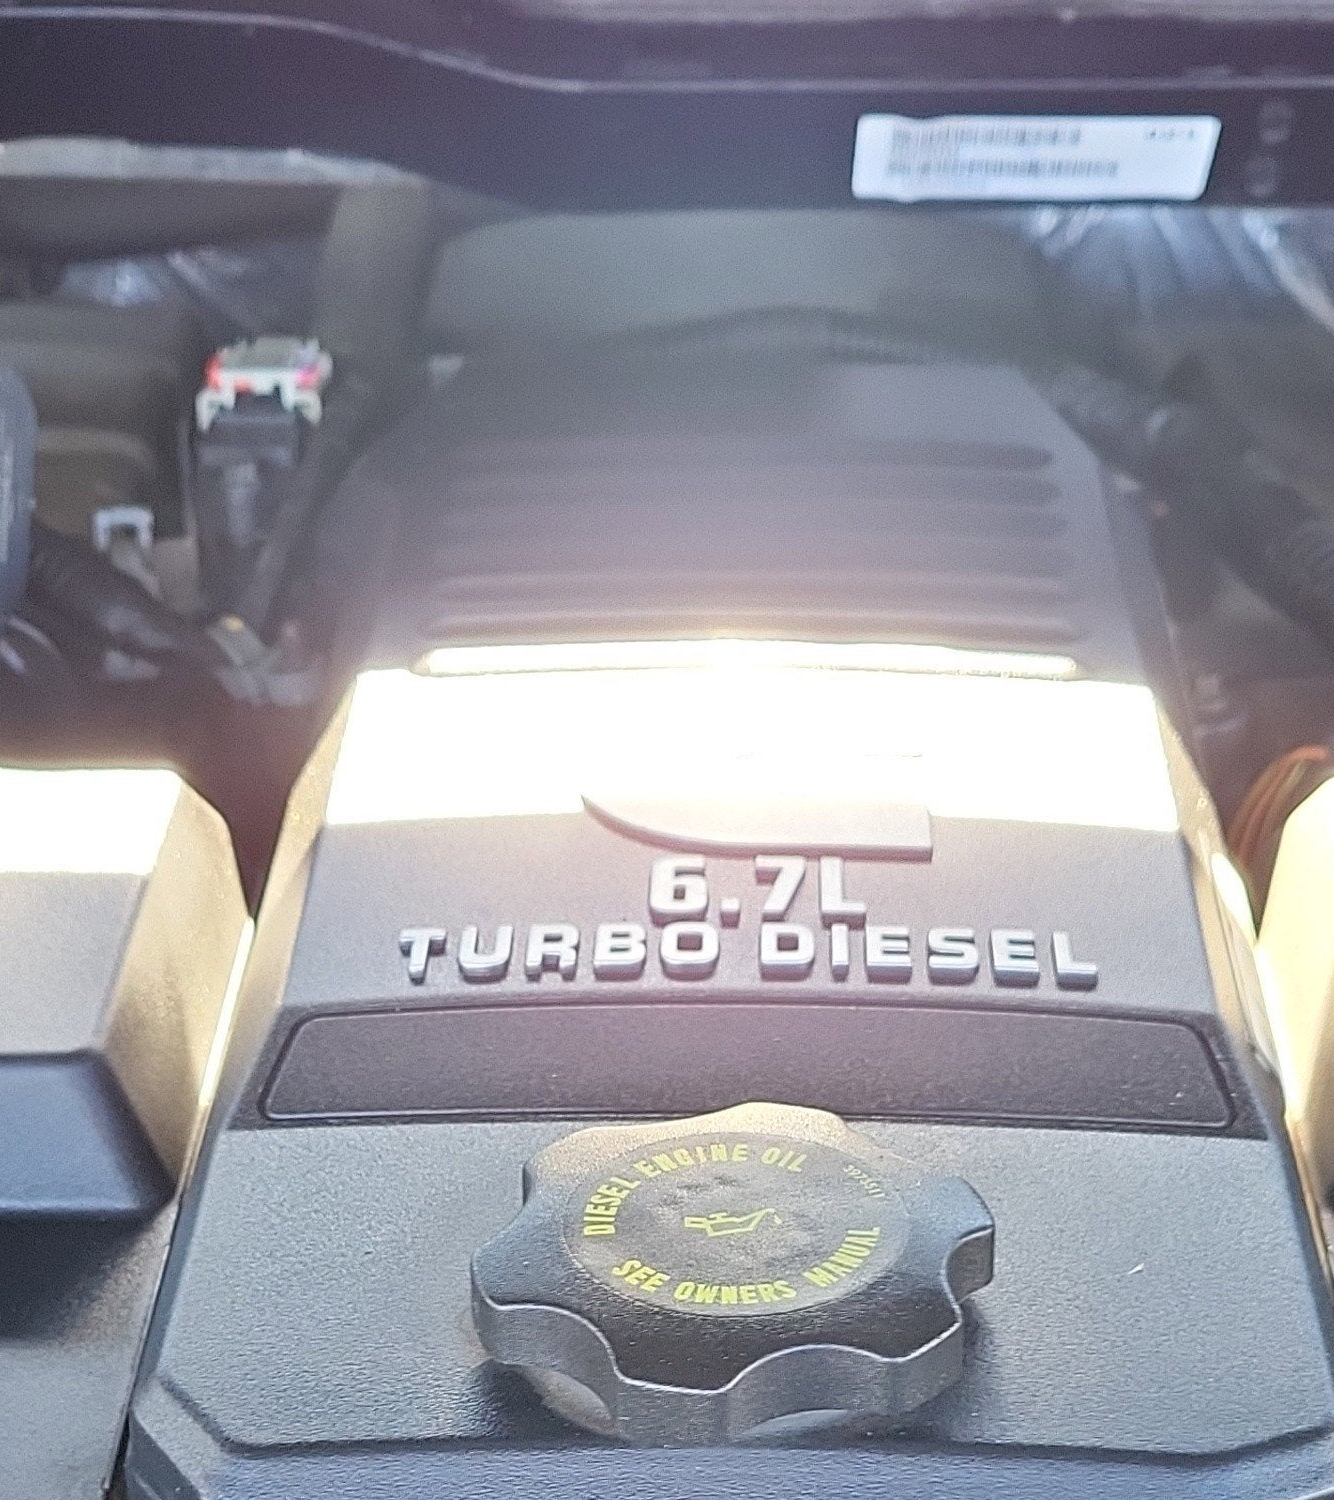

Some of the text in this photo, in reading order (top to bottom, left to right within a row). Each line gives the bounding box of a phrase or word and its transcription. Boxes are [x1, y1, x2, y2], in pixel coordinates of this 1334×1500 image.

[648, 854, 866, 925] 6.7L
[399, 921, 1097, 990] TURBO DIESEL
[583, 1143, 809, 1236] DIESEL ENGINE OIL
[612, 1226, 881, 1305] SEE OWNERS MANUAL
